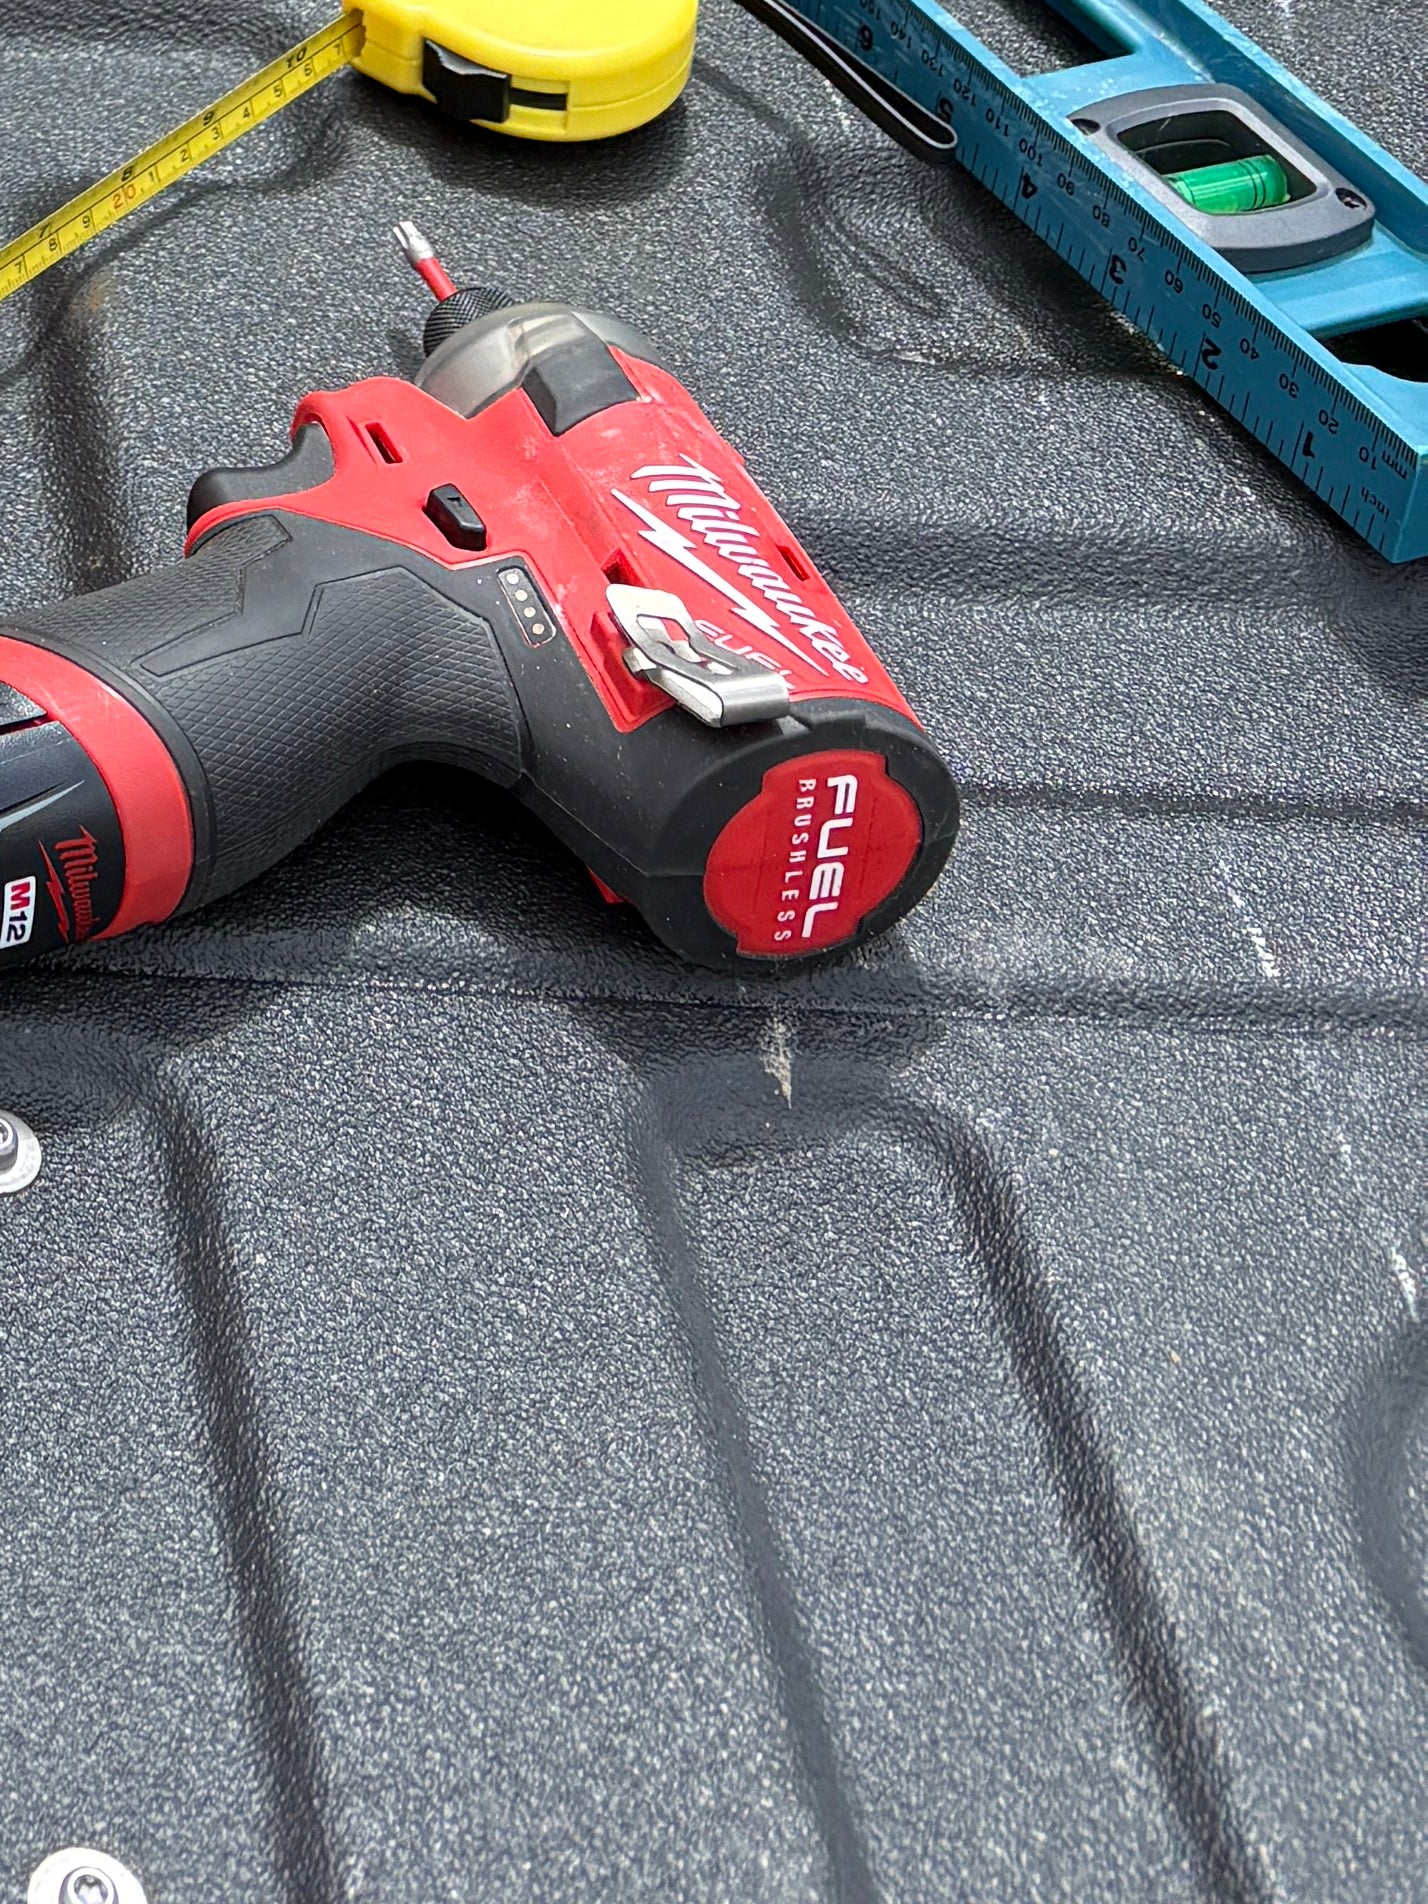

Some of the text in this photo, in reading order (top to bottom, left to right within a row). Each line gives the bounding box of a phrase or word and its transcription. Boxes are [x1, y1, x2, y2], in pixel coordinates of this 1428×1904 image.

[857, 24, 874, 52] 6
[921, 49, 945, 78] 130
[953, 77, 977, 107] 120
[985, 106, 1010, 137] 110
[1018, 137, 1044, 167] 100
[1022, 172, 1038, 199] 4
[1057, 171, 1076, 196] 90
[1091, 203, 1111, 228] 80
[1127, 235, 1146, 260] 70
[1108, 254, 1128, 285] 3
[1164, 268, 1185, 293] 60
[1201, 302, 1222, 328] 50
[1201, 338, 1223, 371] 2
[1239, 337, 1260, 361] 40
[1279, 373, 1299, 398] 30
[1318, 409, 1341, 435] 20
[1301, 430, 1317, 458] 1
[1358, 445, 1379, 471] 10
[1381, 452, 1408, 480] mm
[1360, 486, 1391, 519] inch
[630, 453, 869, 685] Milwaukee
[774, 778, 817, 942] BRUSHLESS
[802, 773, 857, 938] FUEL
[6, 882, 32, 943] M12
